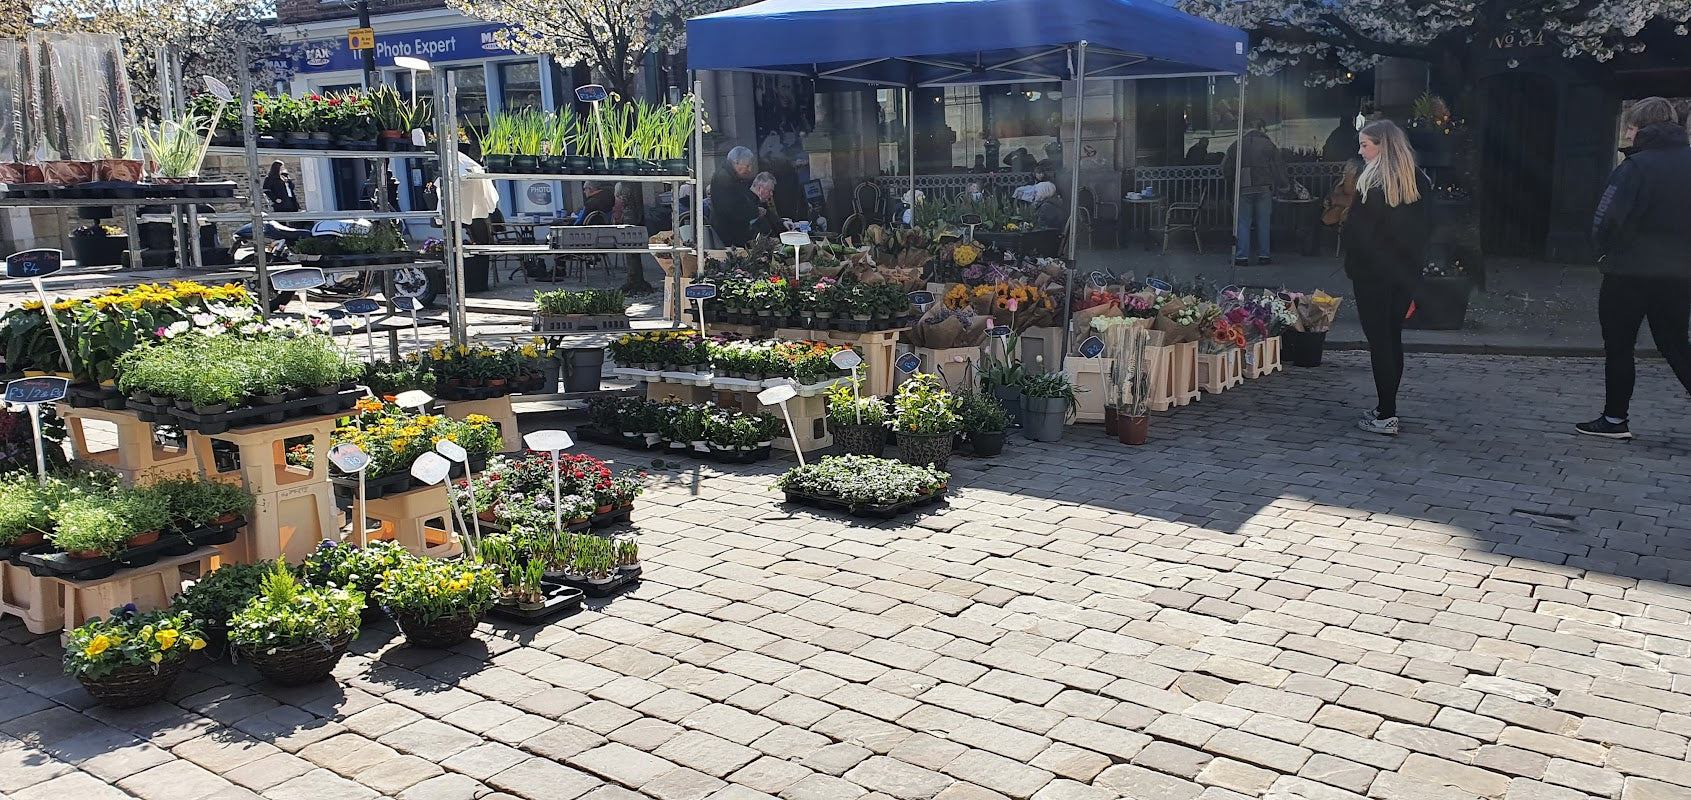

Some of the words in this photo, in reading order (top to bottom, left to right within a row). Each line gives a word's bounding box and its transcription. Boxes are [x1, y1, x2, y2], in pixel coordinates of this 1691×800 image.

[376, 41, 412, 58] Photo
[414, 36, 457, 58] Expert
[1518, 29, 1545, 48] 34
[306, 48, 329, 60] MAX
